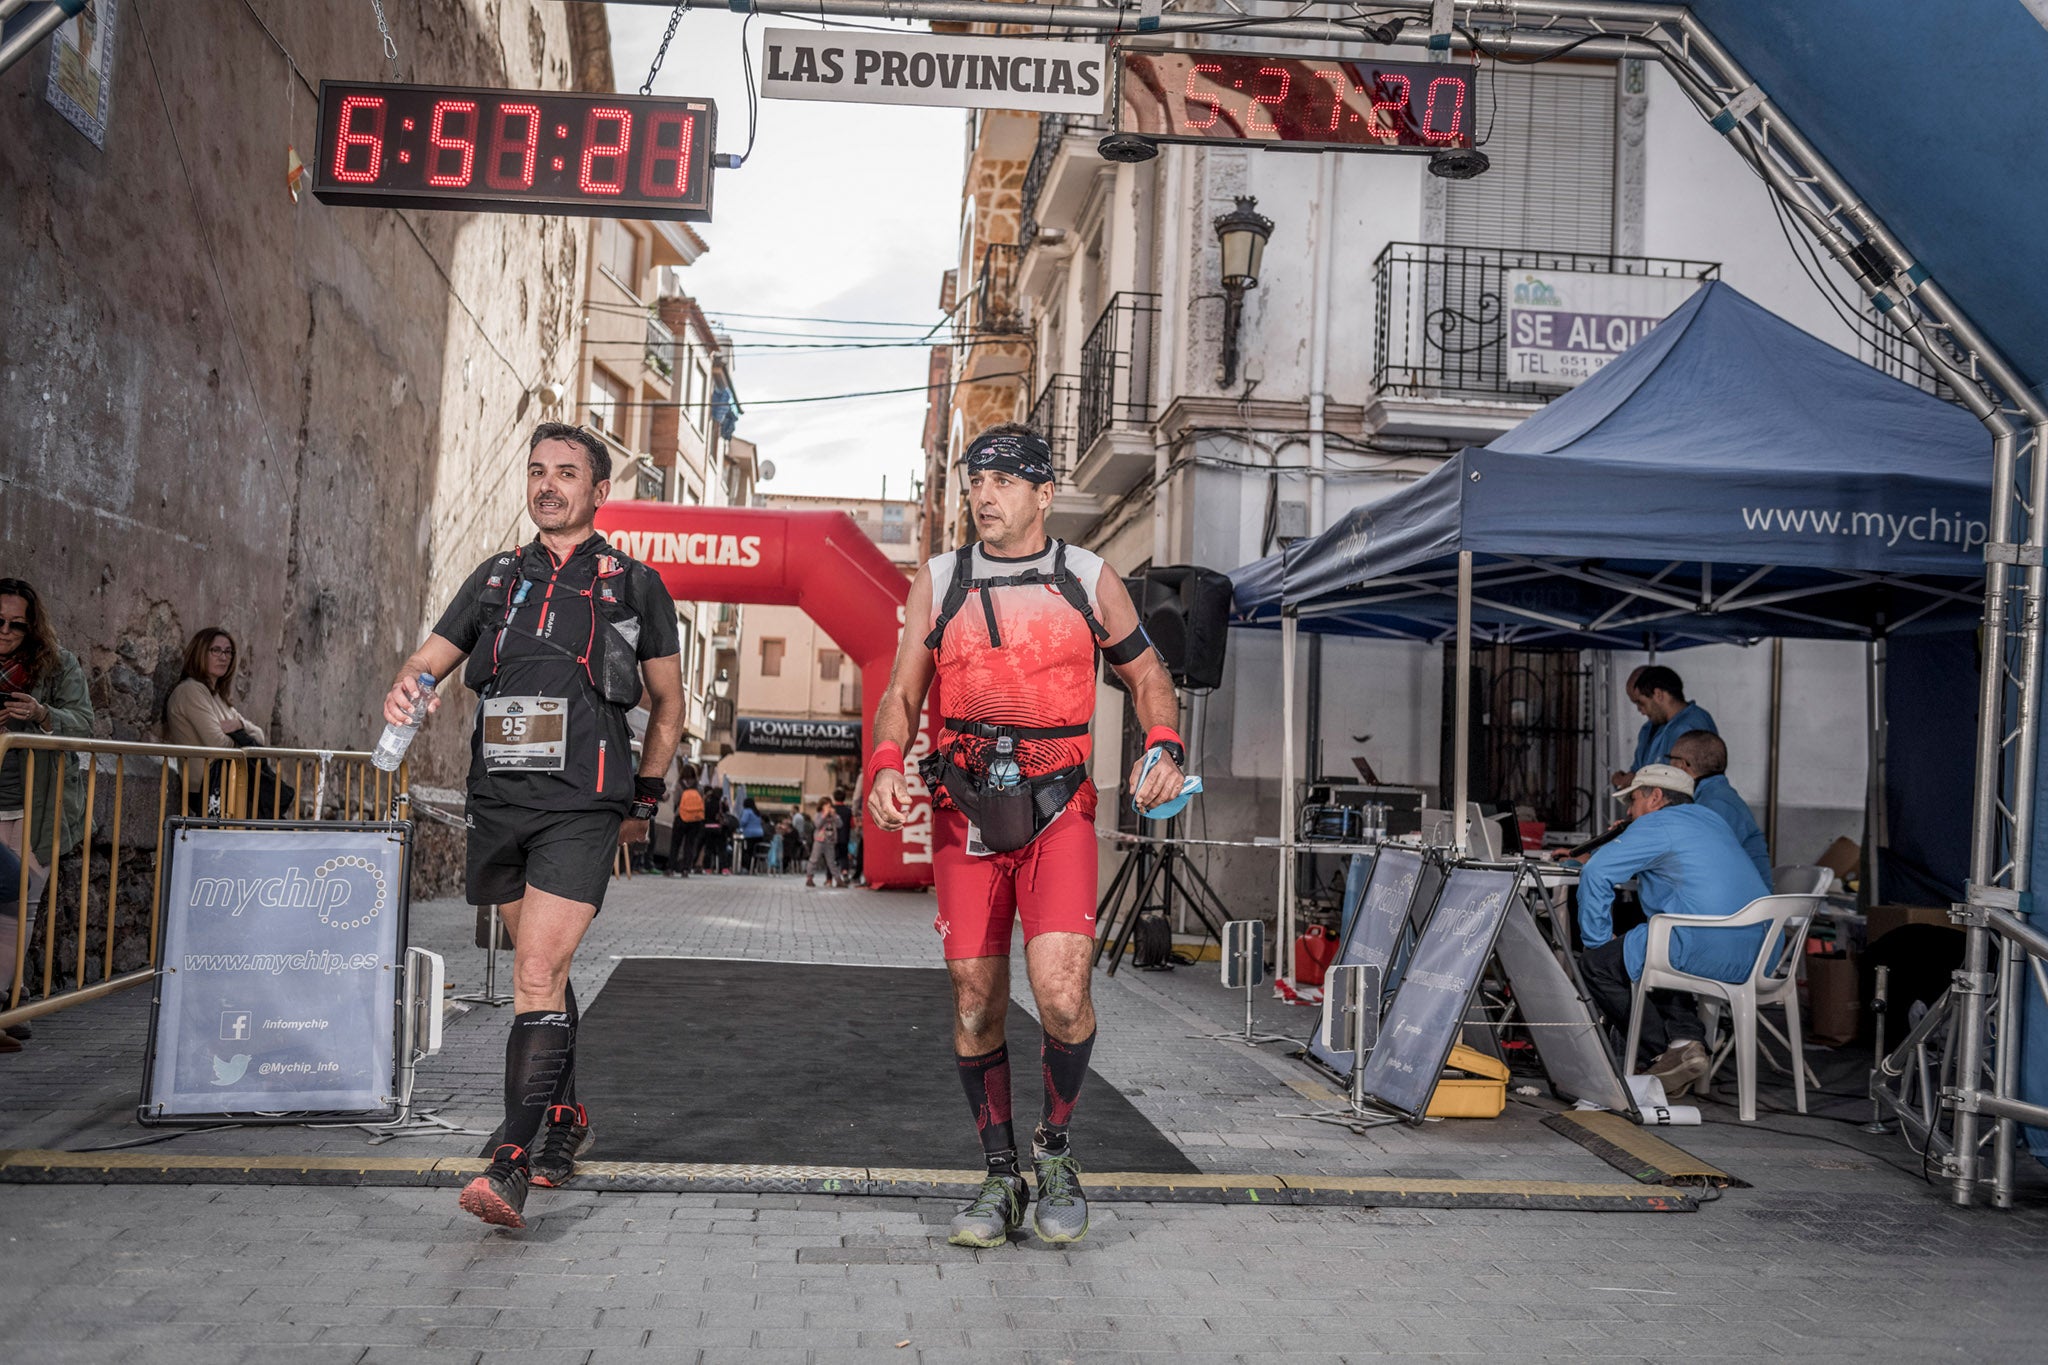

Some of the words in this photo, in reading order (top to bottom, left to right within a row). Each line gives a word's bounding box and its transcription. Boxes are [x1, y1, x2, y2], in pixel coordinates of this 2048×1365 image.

[767, 45, 844, 83] LAS
[854, 49, 1100, 96] PROVINCIAS
[1184, 64, 1466, 141] 5:27:20
[333, 96, 695, 194] 6:57:21
[1516, 313, 1553, 347] SE
[594, 529, 761, 567] OVINCIAS
[501, 717, 527, 736] 95
[902, 803, 934, 864] LAS
[190, 867, 352, 917] mychip
[184, 950, 379, 975] www.mychip.es
[258, 1061, 339, 1075] @Mychip_Info
